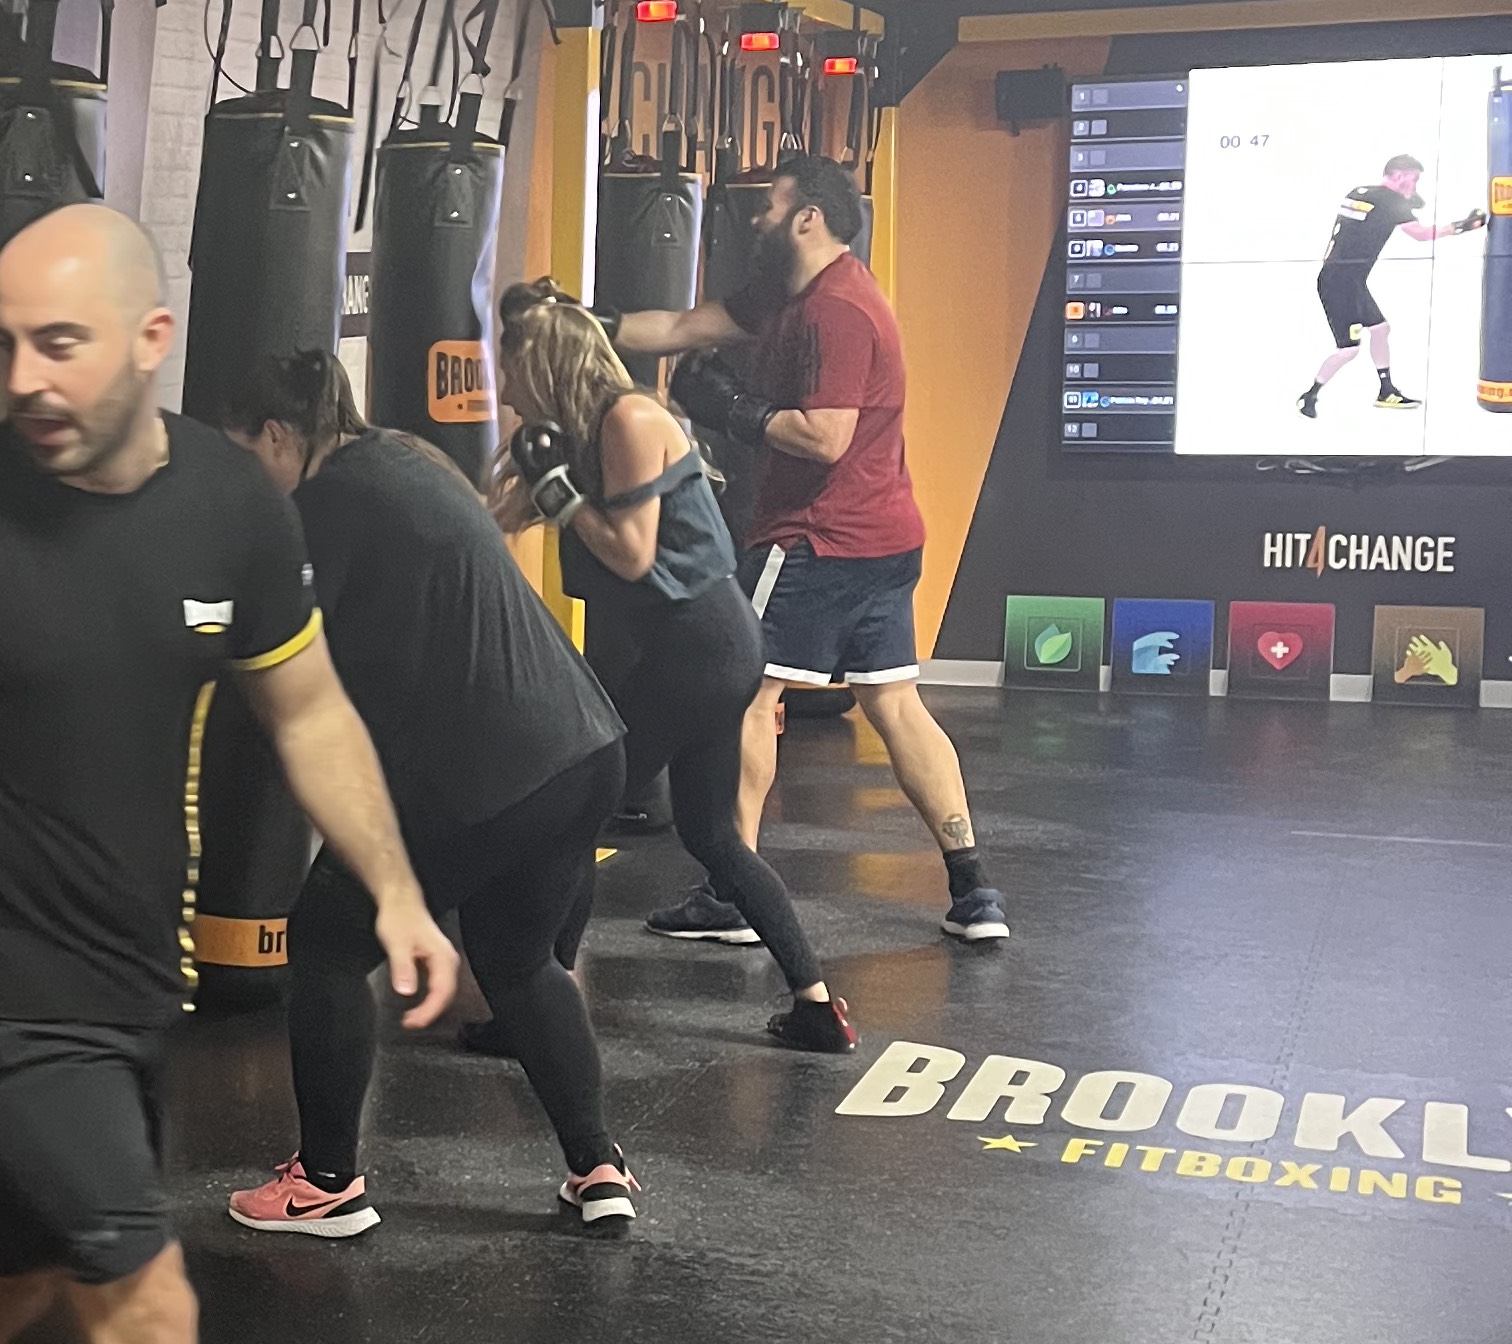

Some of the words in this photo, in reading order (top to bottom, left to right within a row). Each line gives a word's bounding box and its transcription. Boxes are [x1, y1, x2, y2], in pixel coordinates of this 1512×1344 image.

[1250, 134, 1270, 147] 47
[1263, 525, 1456, 579] HIT4CHANGE
[258, 924, 286, 954] br
[835, 1040, 1512, 1174] BROOKL
[1060, 1138, 1463, 1205] FITBOXING
